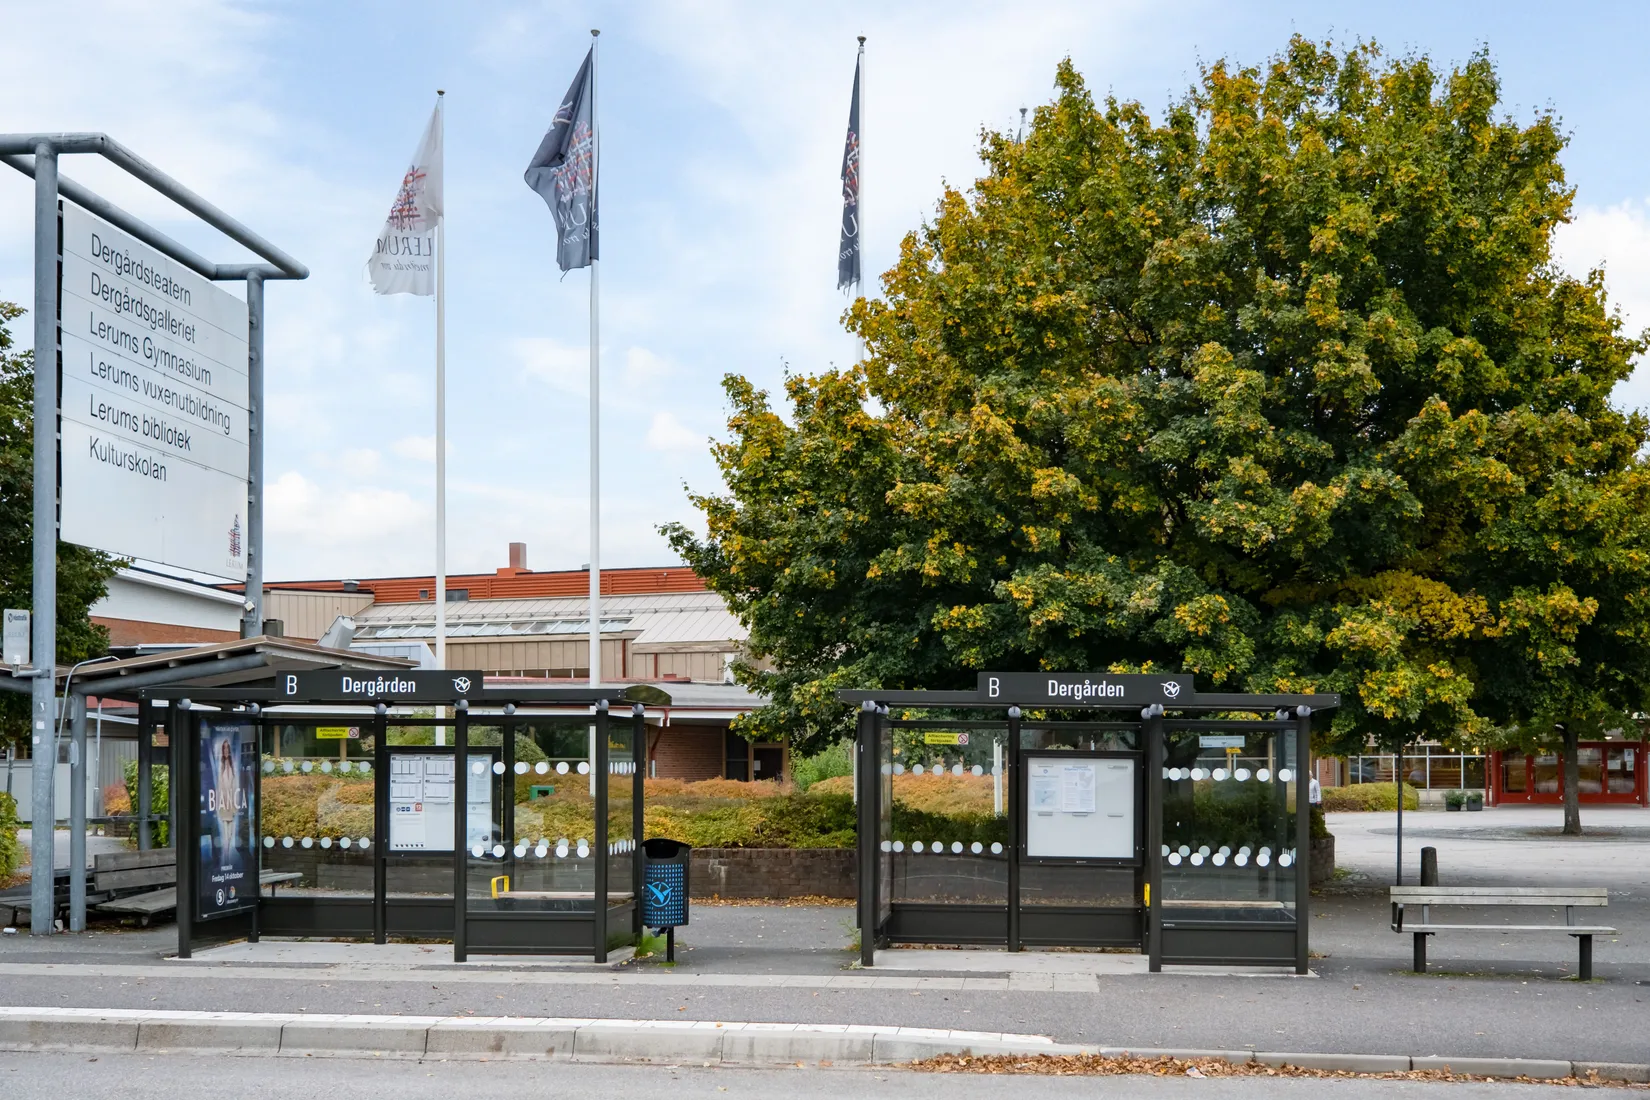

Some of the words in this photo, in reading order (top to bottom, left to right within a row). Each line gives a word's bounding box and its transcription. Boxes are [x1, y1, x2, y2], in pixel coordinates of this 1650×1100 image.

[91, 233, 191, 306] Dergårdsteatern
[91, 271, 196, 344] Dergårdsgalleriet
[90, 311, 139, 354] Lerums
[143, 336, 212, 386] Gymnasium
[90, 351, 139, 392] Lerums
[142, 378, 231, 435] vuxenutbildning
[90, 394, 139, 433] Lerums
[142, 414, 191, 451] bibliotek
[89, 435, 167, 482] Kulturskolan
[286, 675, 297, 695] B
[342, 676, 416, 697] Dergården
[988, 677, 1000, 698] B
[1048, 679, 1124, 700] Dergården
[208, 787, 248, 812] BIANCA
